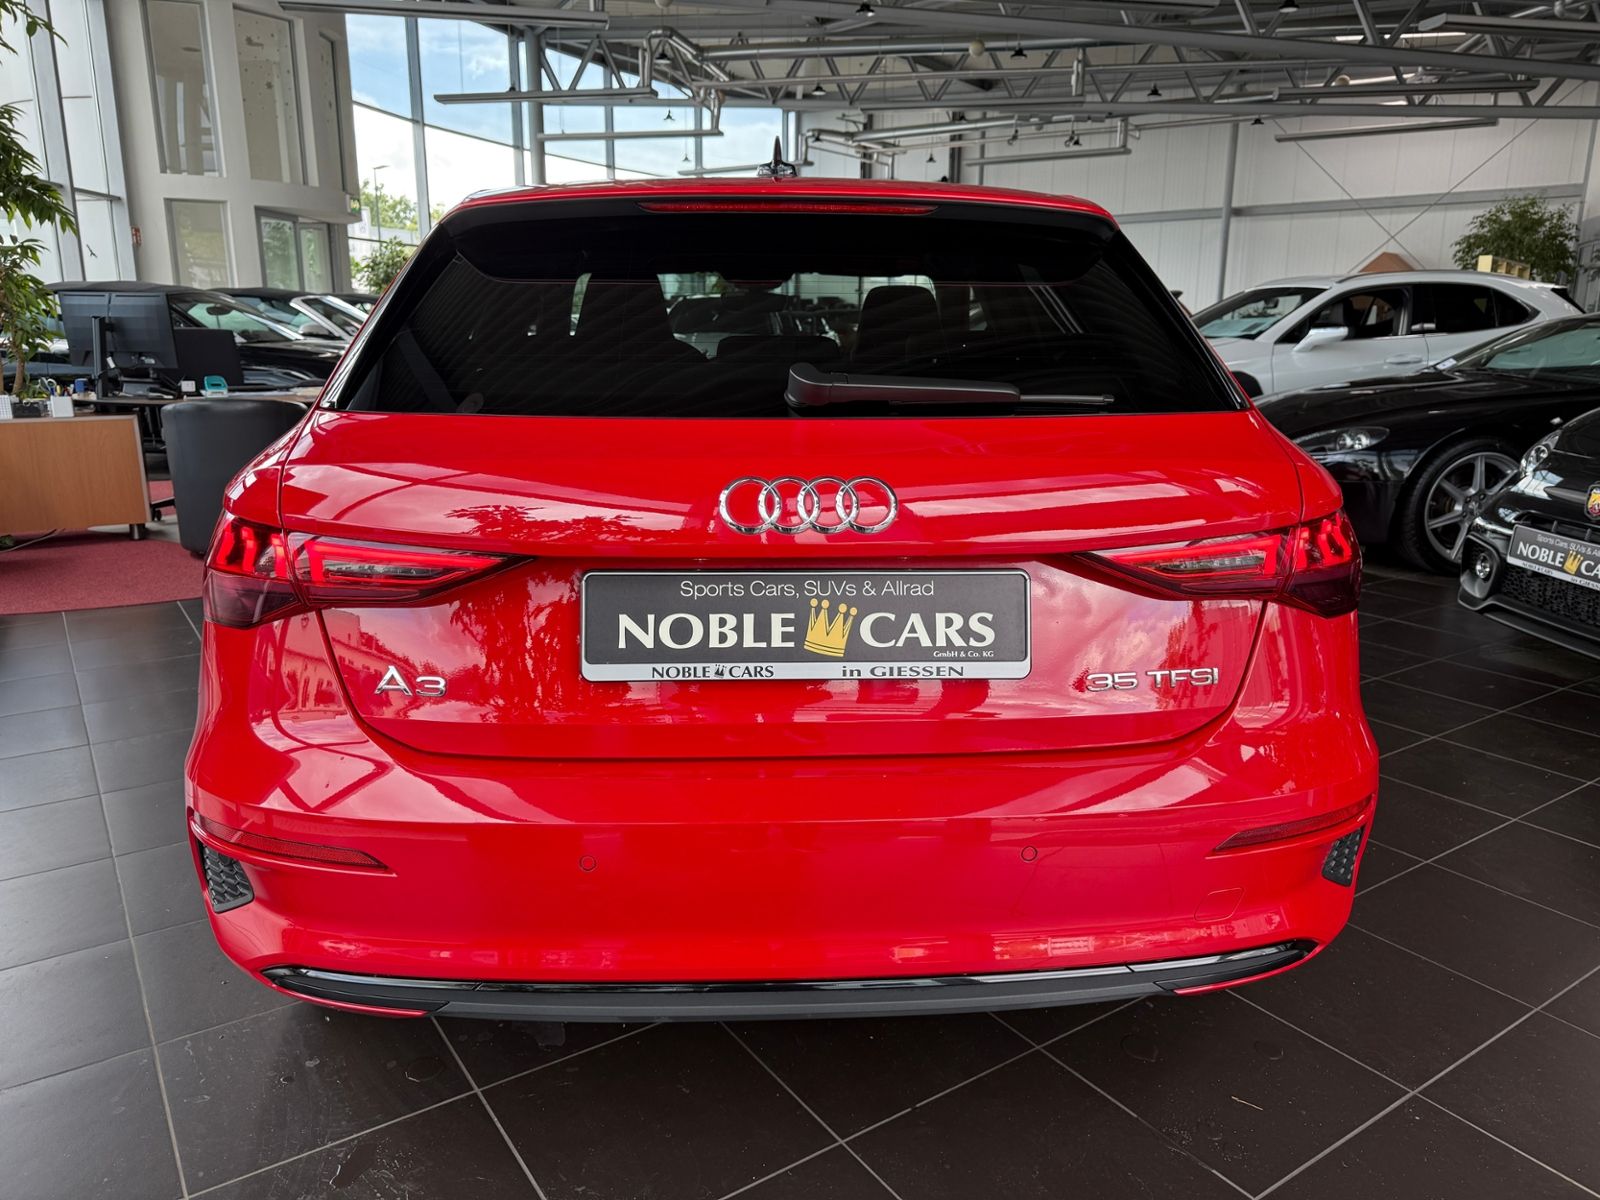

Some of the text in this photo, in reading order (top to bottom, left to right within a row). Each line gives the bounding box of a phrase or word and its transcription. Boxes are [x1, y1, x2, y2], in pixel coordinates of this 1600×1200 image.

[1517, 541, 1565, 567] NOBLE
[680, 580, 935, 600] Sports Cars, SUVs & Allrad
[618, 611, 996, 649] NOBLE CARS
[933, 650, 994, 658] GmbH & Co. KG
[374, 665, 447, 697] A3
[651, 665, 964, 679] NOBLE CARS in GIESSEN
[1086, 667, 1219, 692] 35 TFSI
